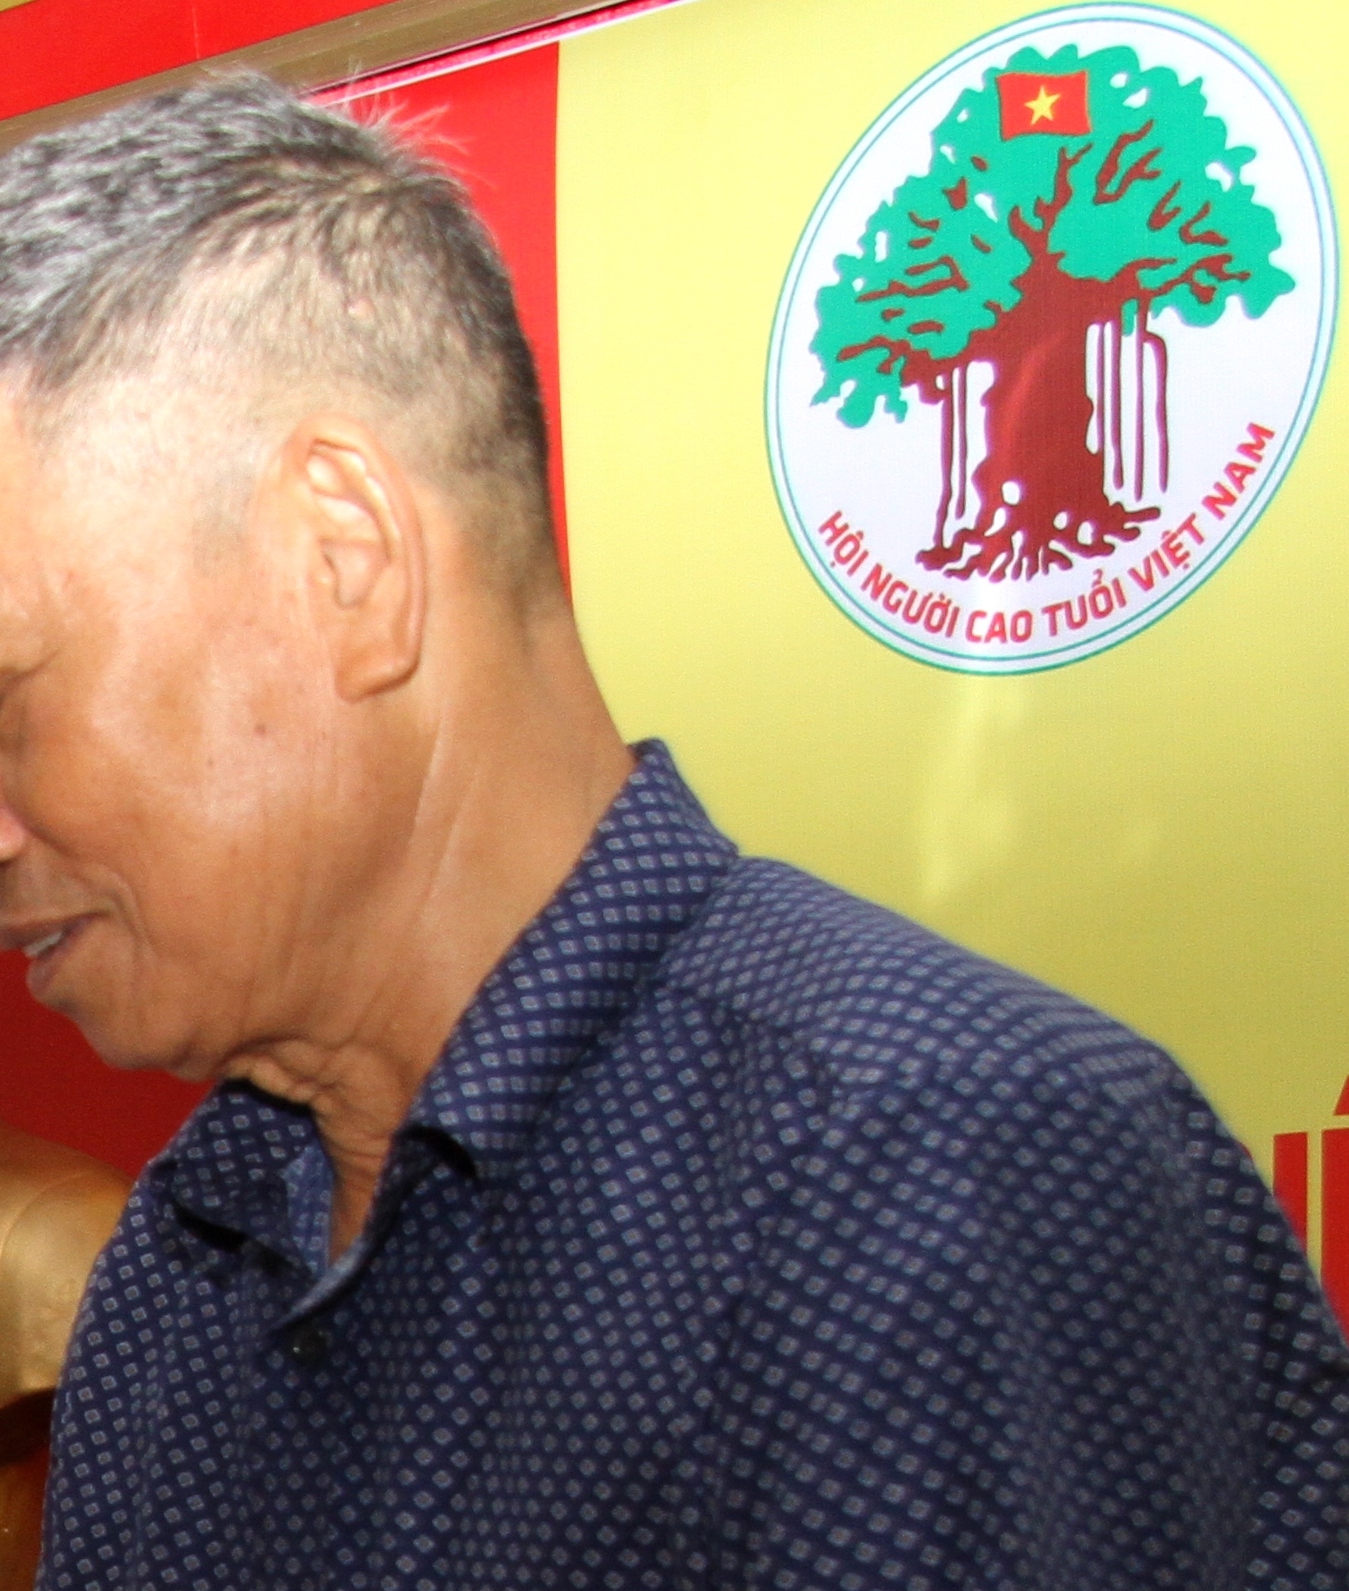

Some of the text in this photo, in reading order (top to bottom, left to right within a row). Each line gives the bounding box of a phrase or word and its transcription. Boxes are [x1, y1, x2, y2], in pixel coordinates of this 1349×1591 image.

[817, 421, 1277, 645] HỘI NGƯỜI CAO TUỔI VIỆT NAM
